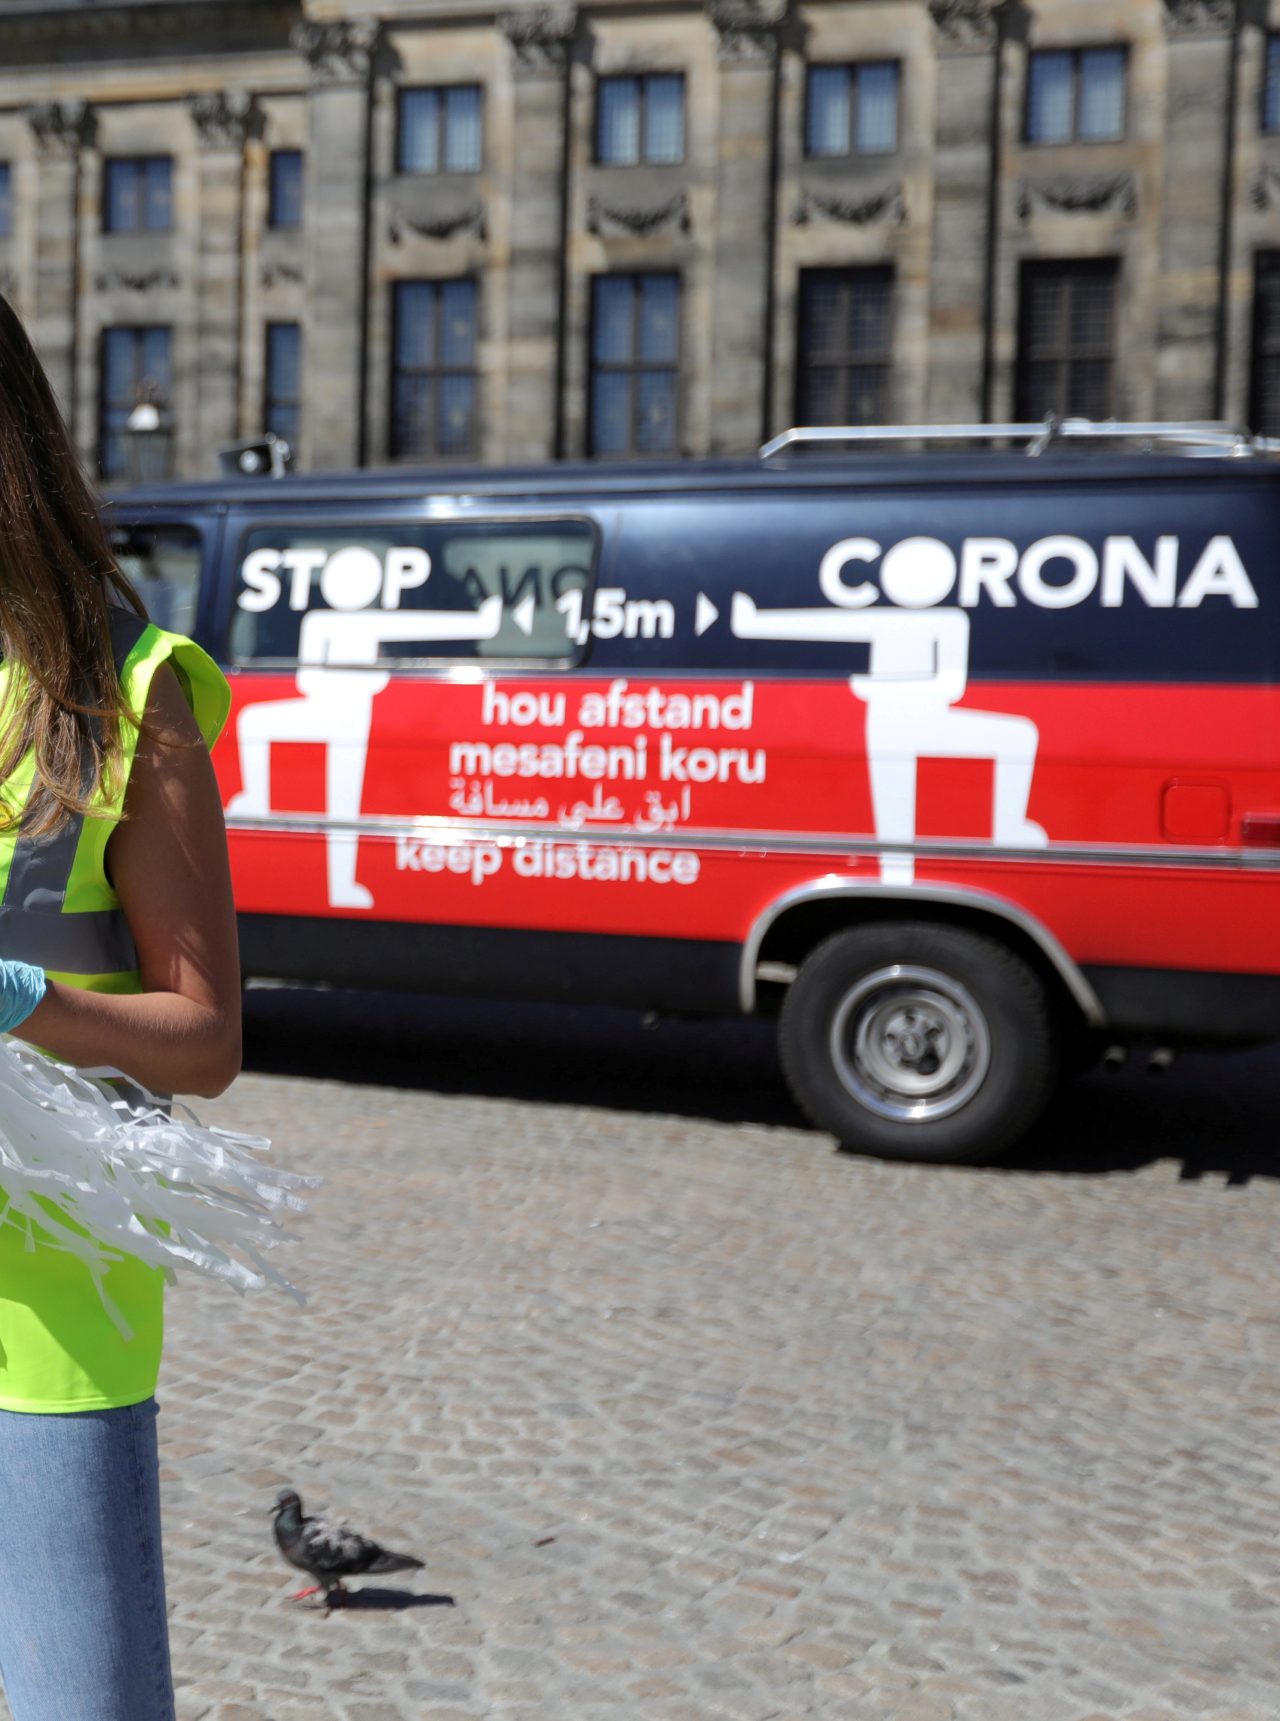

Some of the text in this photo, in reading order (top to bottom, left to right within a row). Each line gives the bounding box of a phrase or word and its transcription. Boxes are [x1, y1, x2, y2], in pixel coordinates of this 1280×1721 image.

[237, 546, 432, 612] STOP
[819, 534, 1260, 610] CORONA
[556, 587, 676, 646] 1,5m
[481, 679, 755, 732] hou afstand
[448, 730, 766, 785] mesafeni koru
[448, 776, 550, 818] مسافة
[395, 836, 702, 886] keep distance
